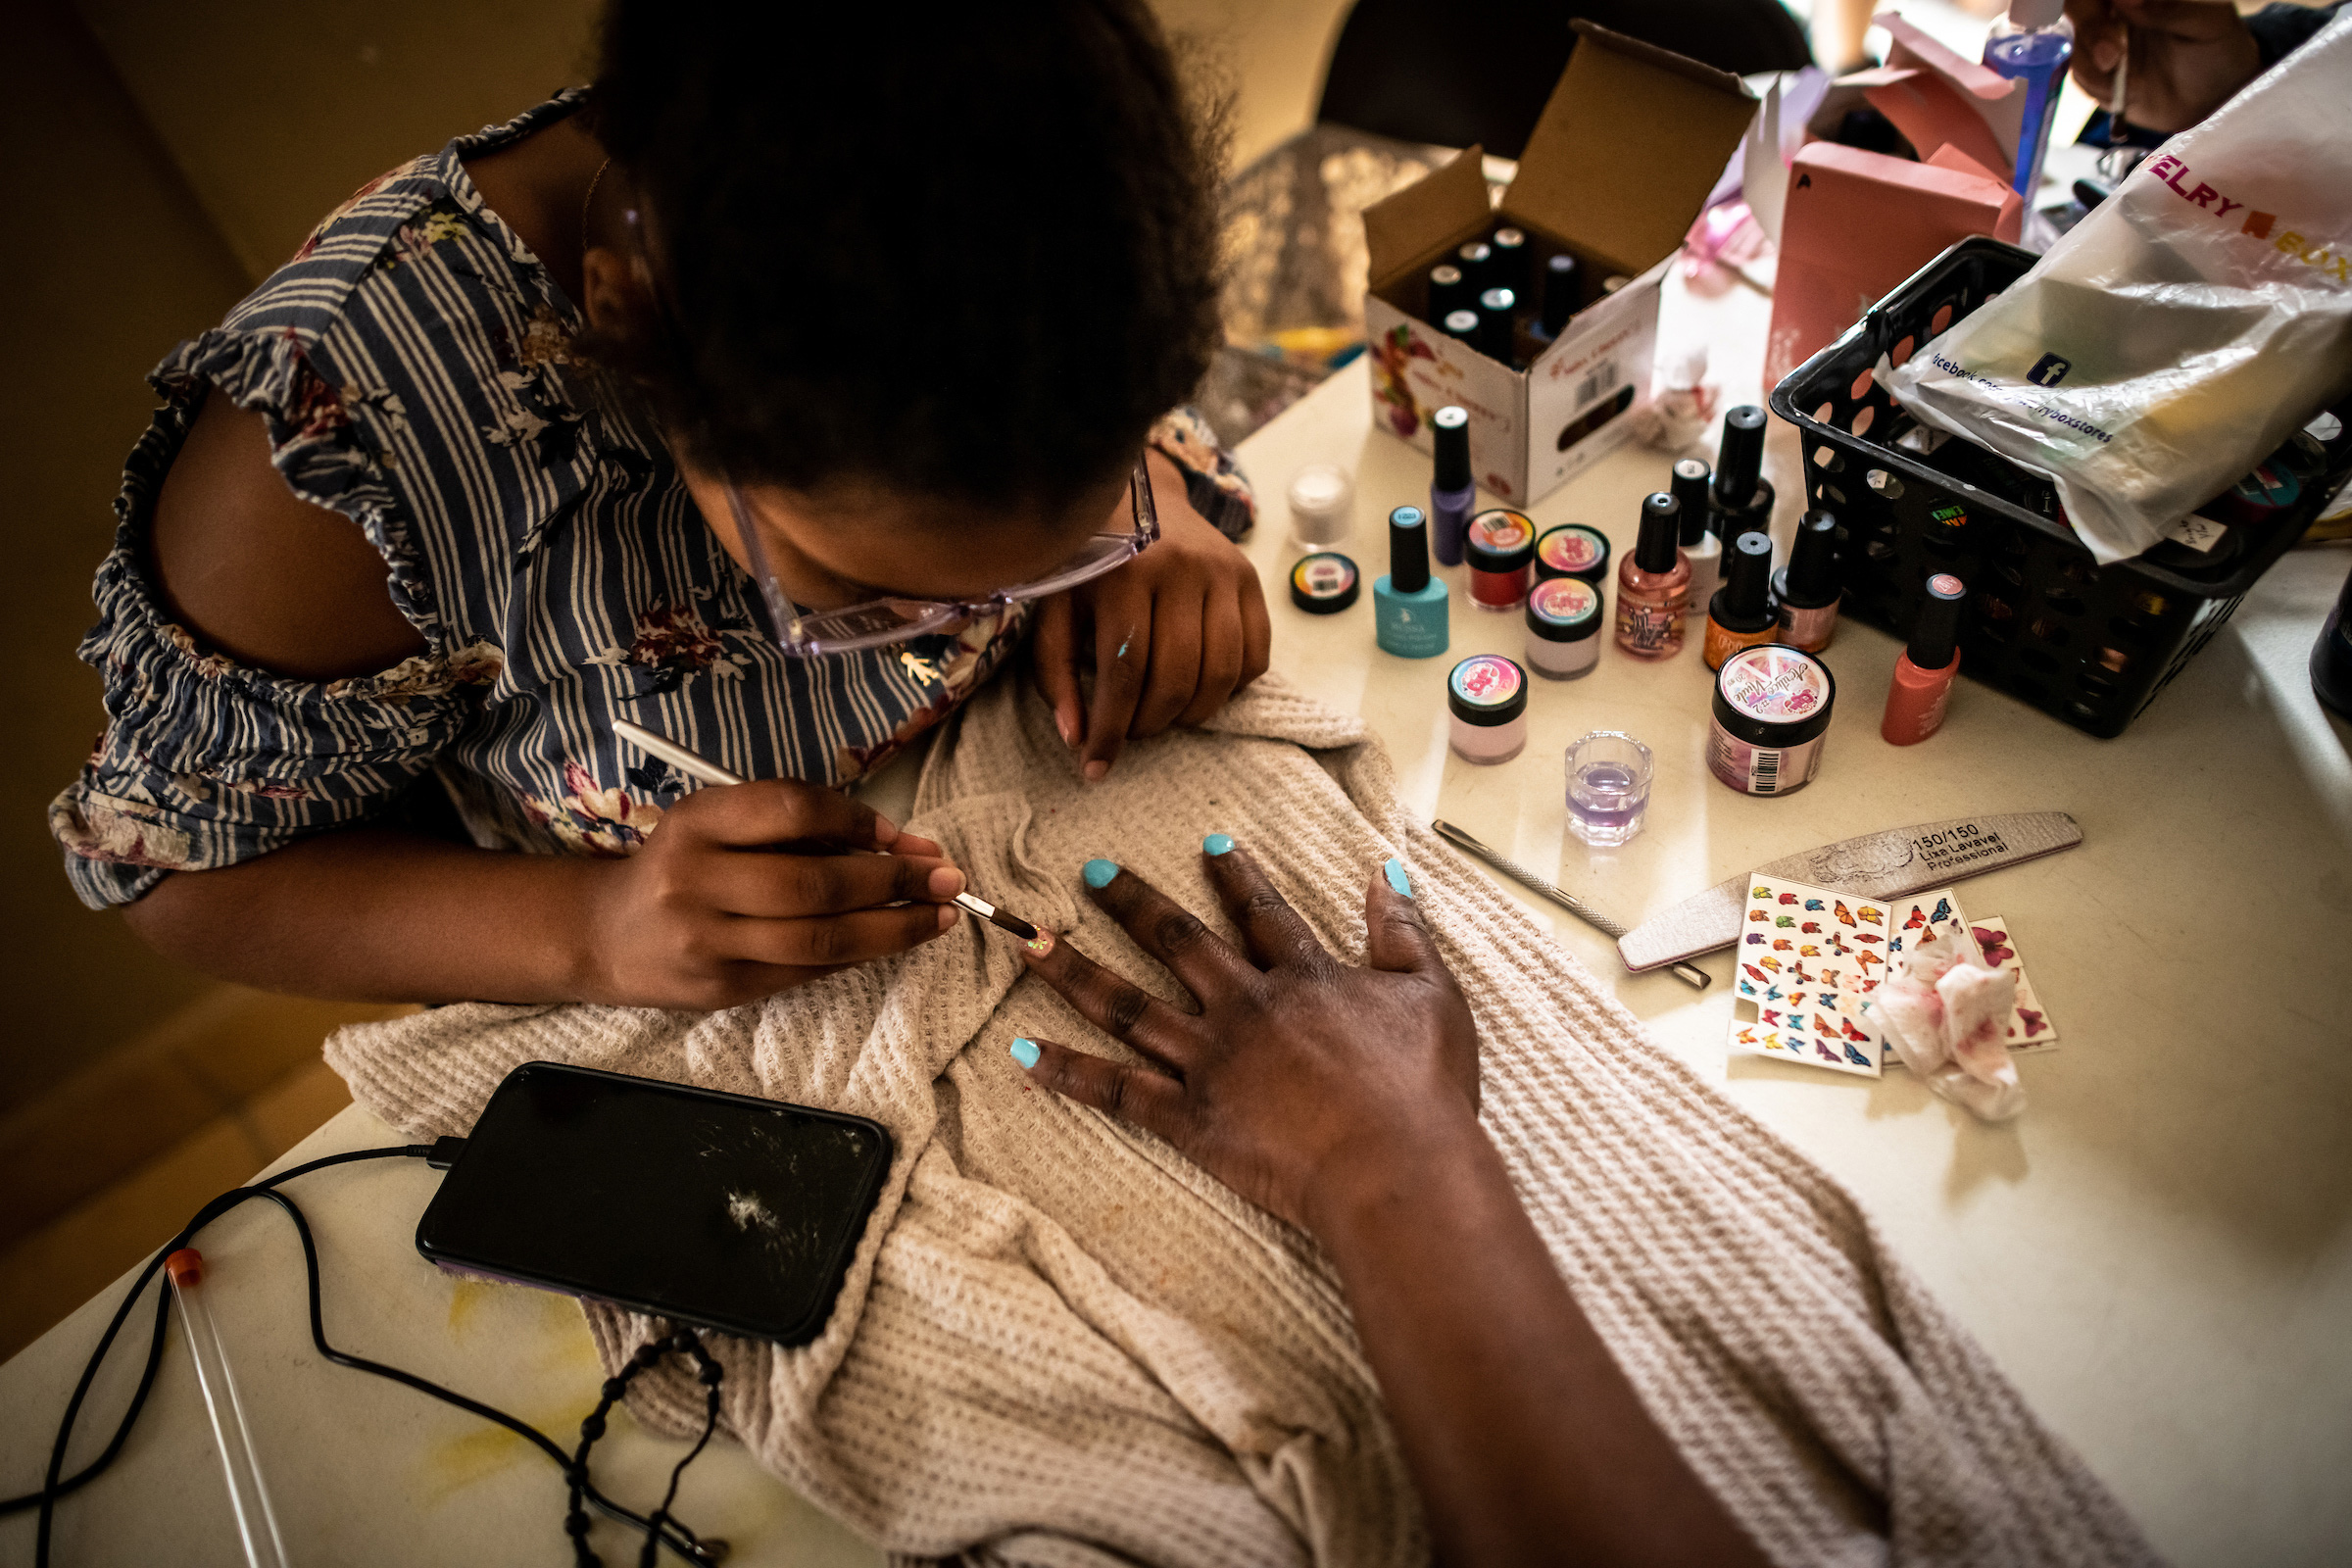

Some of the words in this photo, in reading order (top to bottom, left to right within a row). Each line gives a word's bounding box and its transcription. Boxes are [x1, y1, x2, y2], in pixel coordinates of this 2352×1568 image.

[1734, 679, 1773, 704] Nude
[1913, 824, 1979, 851] 150/150
[1919, 848, 1948, 861] Lixa
[1948, 832, 2000, 853] Lavavel
[1927, 842, 2008, 870] Professional
